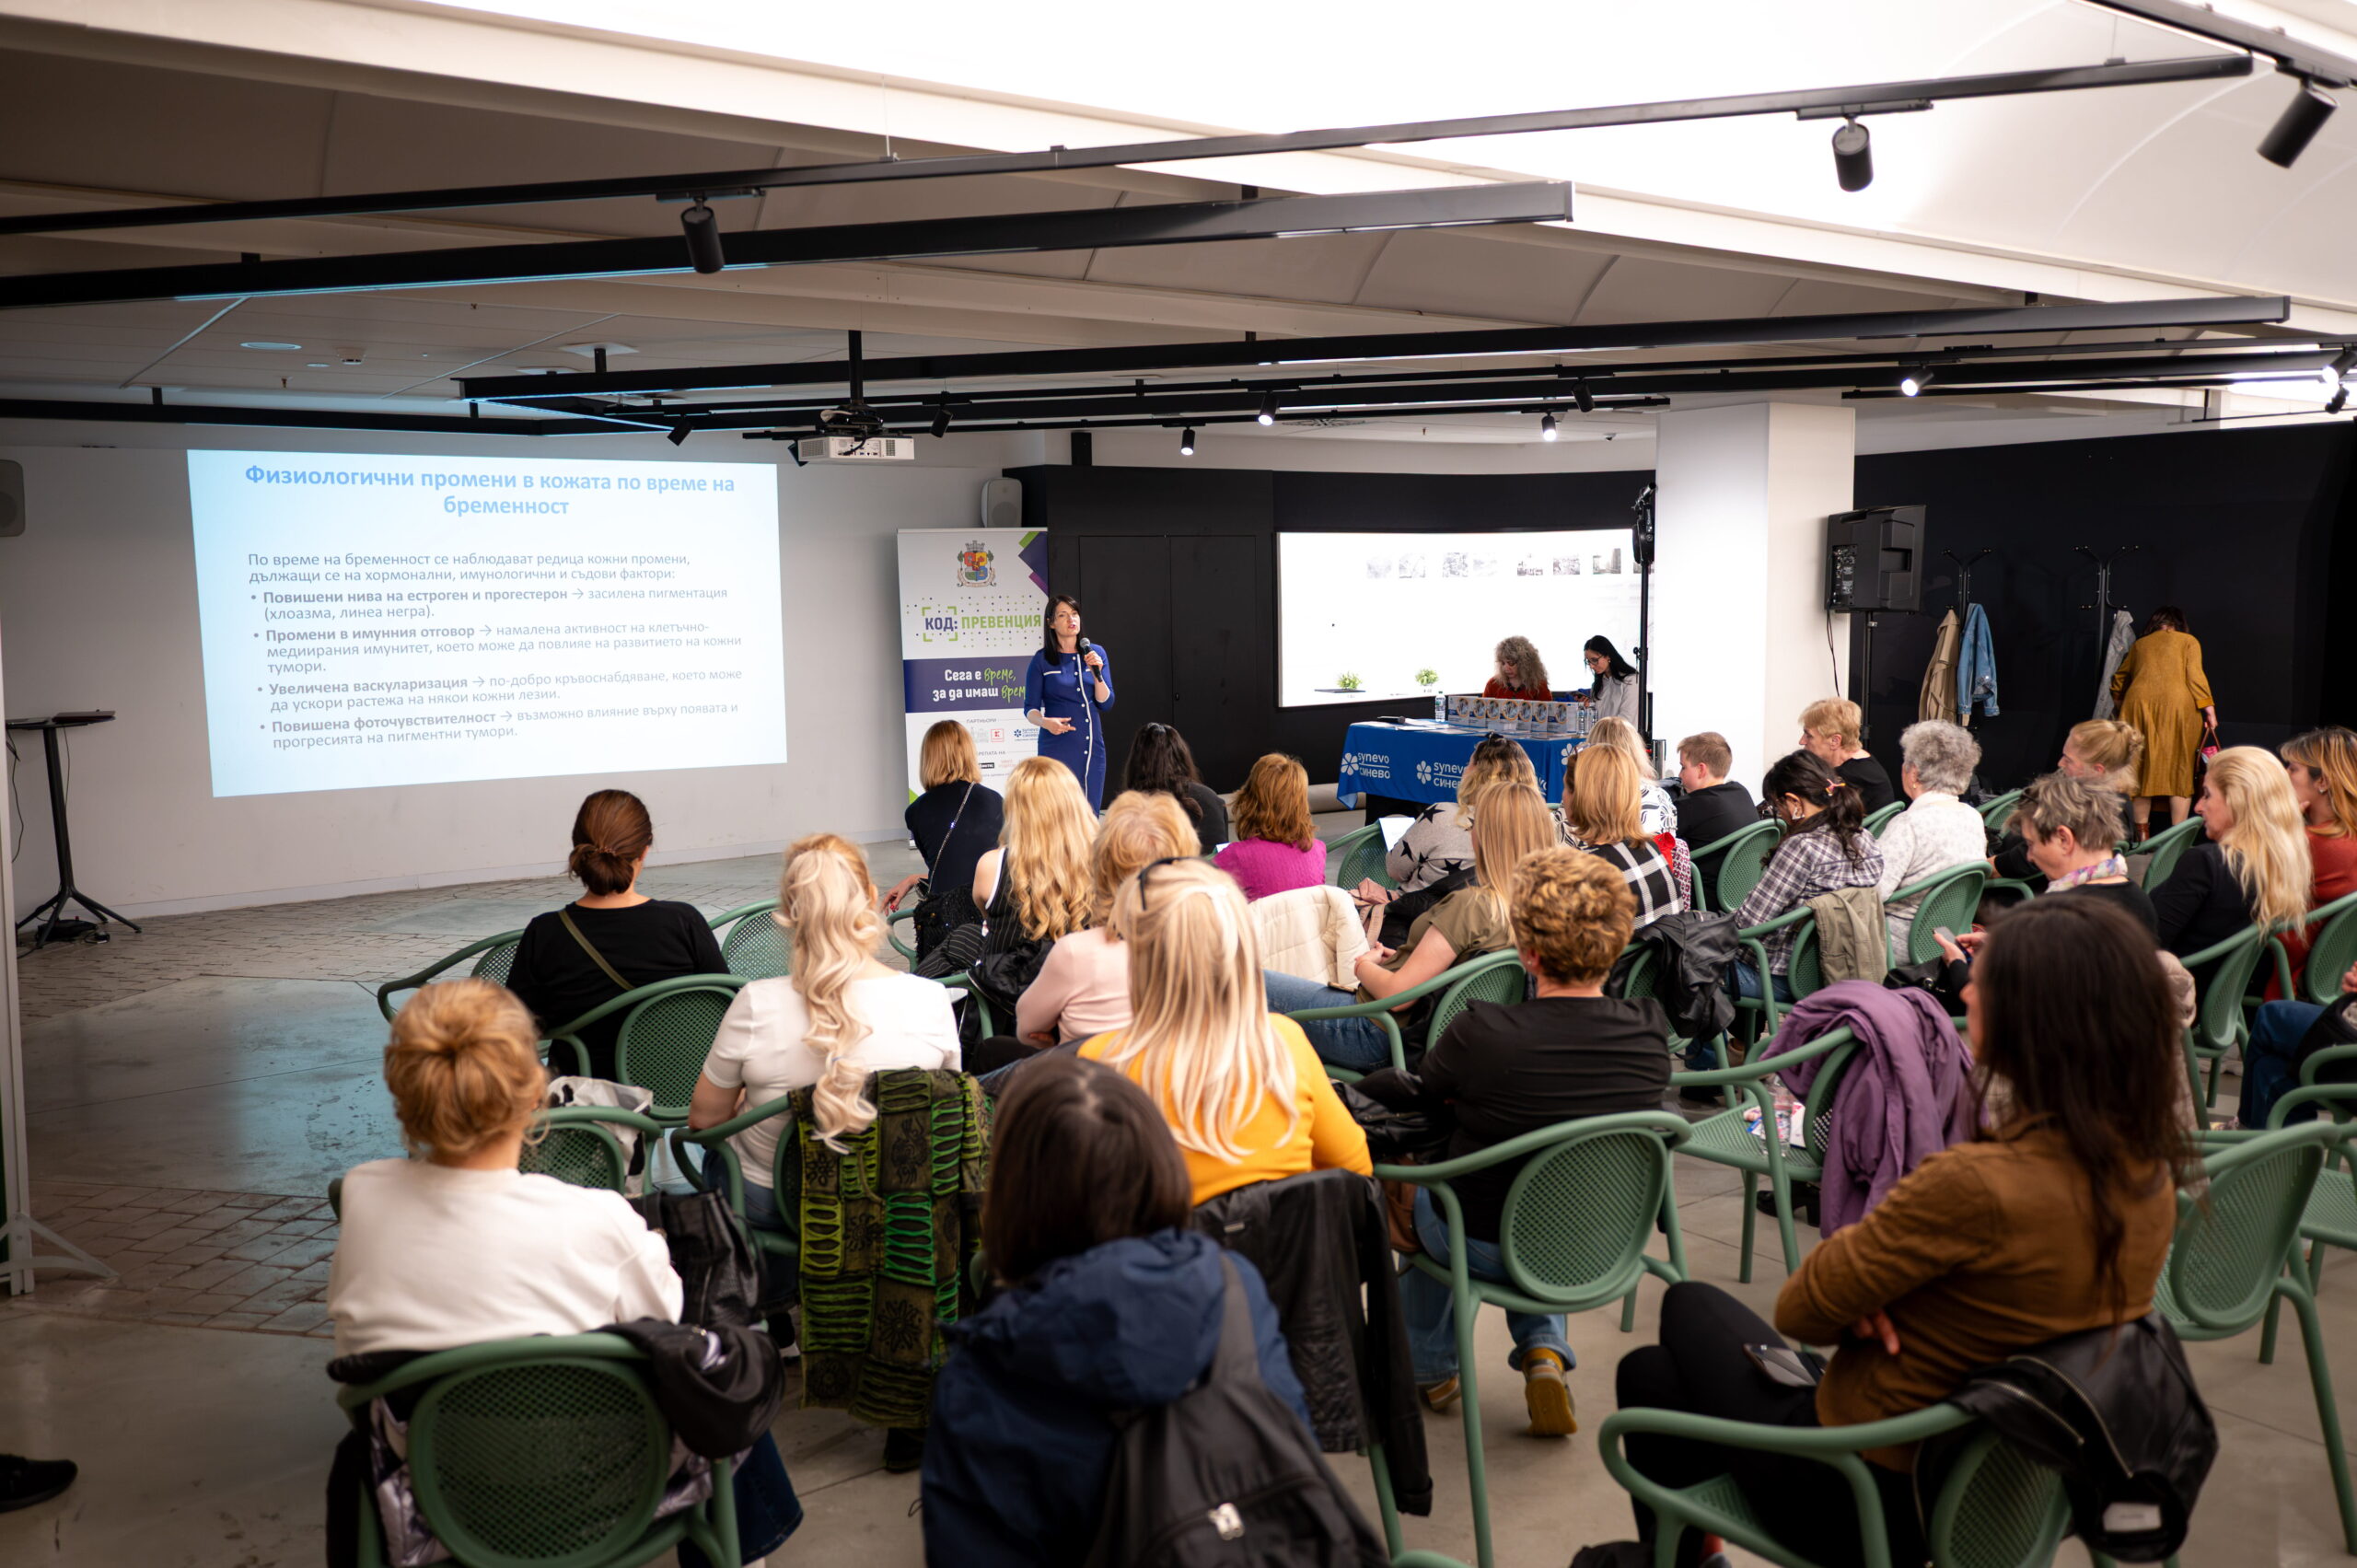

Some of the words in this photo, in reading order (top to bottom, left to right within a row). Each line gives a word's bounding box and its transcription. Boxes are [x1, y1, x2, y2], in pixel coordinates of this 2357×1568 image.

[246, 465, 414, 486] Физиологични
[421, 473, 517, 491] промени
[523, 475, 534, 488] в
[540, 476, 611, 490] кожата
[618, 477, 641, 490] по
[647, 478, 707, 494] време
[713, 479, 735, 492] на
[444, 495, 570, 517] бременност
[249, 552, 268, 565] По
[273, 555, 319, 568] време
[324, 555, 341, 565] на
[345, 552, 431, 567] бременност
[435, 555, 448, 564] се
[453, 552, 533, 566] наблюдават
[537, 554, 584, 566] редица
[587, 554, 628, 564] кожни
[632, 554, 690, 566] промени,
[249, 572, 320, 585] дължащи
[325, 571, 340, 581] се
[344, 571, 361, 581] на
[366, 571, 456, 583] хормонални,
[460, 570, 555, 582] имунологични
[560, 570, 567, 578] и
[571, 570, 616, 581] съдови
[620, 567, 675, 581] фактори:
[263, 591, 343, 603] Повишени
[347, 592, 382, 602] нива
[387, 592, 403, 601] на
[407, 591, 468, 603] естроген
[472, 591, 481, 600] и
[485, 589, 567, 603] прогестерон
[588, 589, 644, 599] засилена
[649, 588, 727, 599] пигментация
[265, 606, 335, 622] (хлоазма,
[340, 608, 382, 618] линеа
[387, 604, 435, 619] негра).
[924, 617, 958, 632] КОД:
[961, 614, 1041, 629] ПРЕВЕНЦИЯ
[266, 629, 336, 644] Промени
[341, 630, 348, 640] в
[353, 628, 416, 641] имунния
[421, 626, 475, 639] отговор
[497, 625, 561, 635] намалена
[564, 623, 627, 633] активност
[631, 623, 644, 633] на
[649, 622, 709, 633] клетъчно-
[267, 645, 359, 659] медиирания
[364, 644, 432, 656] имунитет,
[436, 642, 474, 652] което
[479, 641, 515, 651] може
[518, 640, 534, 652] да
[539, 639, 591, 649] повлияе
[596, 639, 610, 648] на
[613, 637, 682, 650] развитието
[686, 637, 700, 646] на
[703, 636, 741, 646] кожни
[267, 662, 326, 676] тумори.
[945, 669, 972, 681] Сега
[975, 670, 981, 680] е
[984, 668, 1016, 686] време,
[269, 682, 349, 695] Увеличена
[354, 678, 468, 693] васкуларизация
[490, 672, 552, 688] по-добро
[555, 670, 668, 686] кръвоснабдяване,
[672, 670, 706, 680] което
[709, 669, 742, 679] може
[271, 701, 288, 714] да
[292, 699, 343, 713] ускори
[347, 696, 403, 710] растежа
[408, 694, 424, 704] на
[428, 693, 468, 703] някои
[472, 691, 515, 702] кожни
[518, 690, 560, 700] лезии.
[948, 689, 963, 701] да
[965, 688, 998, 698] имаш
[1001, 685, 1026, 703] врем
[273, 719, 350, 733] Повишена
[354, 713, 496, 731] фоточувствителност
[517, 709, 584, 721] възможно
[587, 707, 639, 718] влияние
[643, 706, 677, 717] върху
[680, 703, 727, 714] появата
[731, 703, 737, 712] и
[273, 734, 363, 750] прогресията
[367, 733, 383, 743] на
[388, 729, 461, 742] пигментни
[465, 726, 517, 740] тумори.
[1357, 752, 1389, 764] synevo
[1359, 767, 1391, 779] синево
[1434, 761, 1464, 774] synev
[1434, 777, 1458, 789] сине
